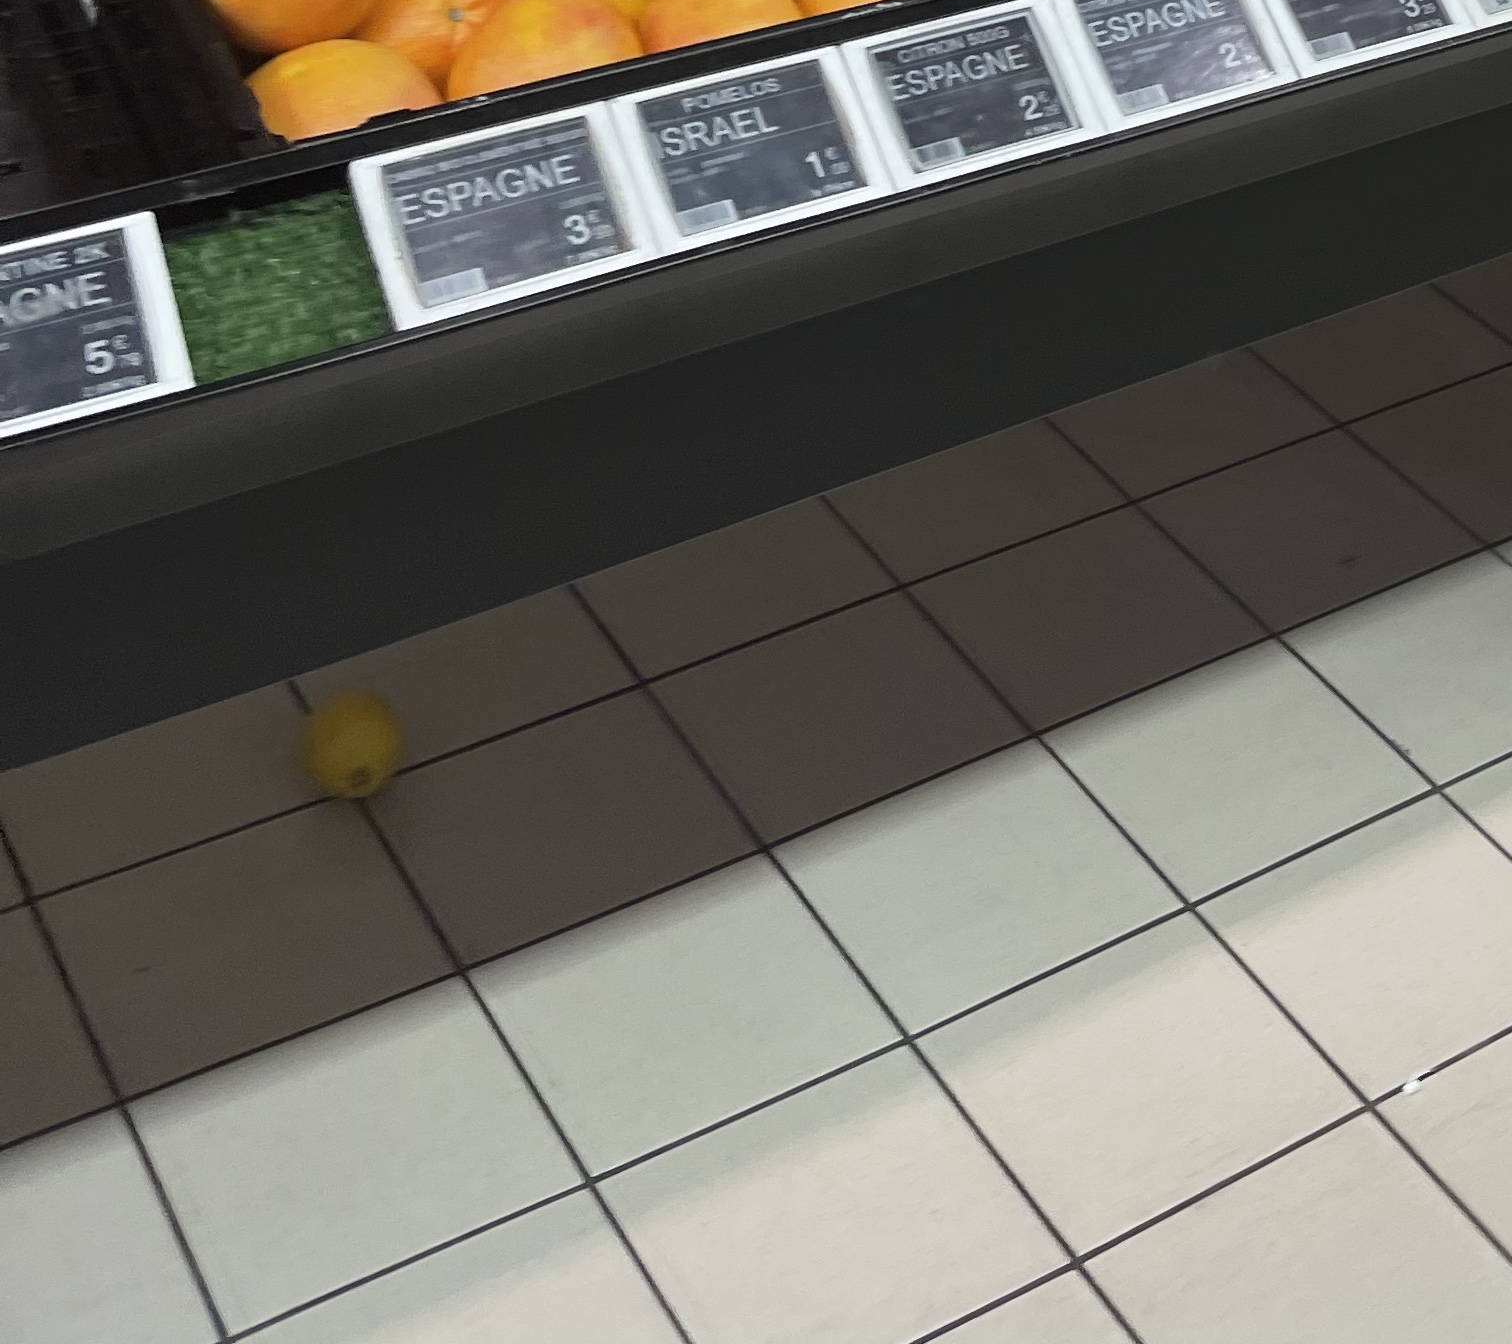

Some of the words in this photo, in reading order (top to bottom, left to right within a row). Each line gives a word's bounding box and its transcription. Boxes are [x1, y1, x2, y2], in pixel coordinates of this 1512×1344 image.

[680, 77, 783, 114] POMELOS
[885, 43, 1031, 102] ESPAGNE
[393, 153, 582, 226] ESPAGNE
